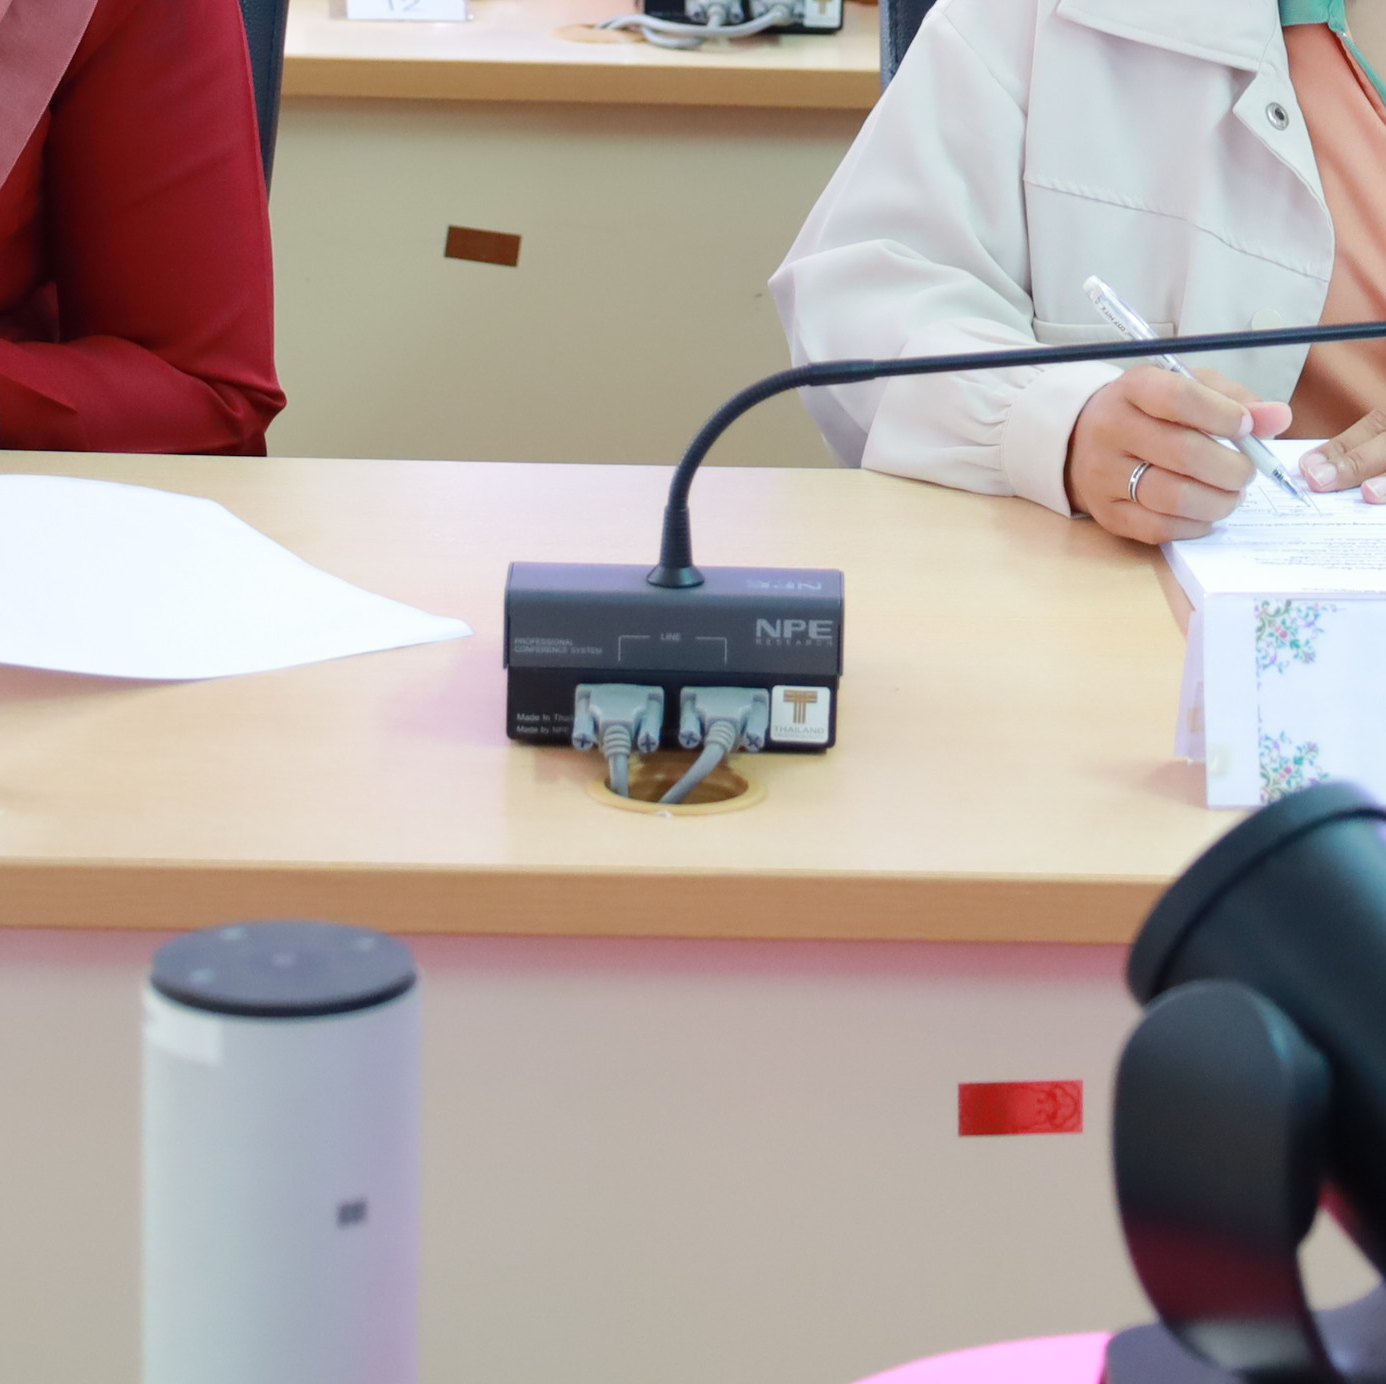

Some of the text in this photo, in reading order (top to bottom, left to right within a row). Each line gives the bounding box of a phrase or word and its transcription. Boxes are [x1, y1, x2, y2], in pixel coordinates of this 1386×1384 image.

[756, 618, 833, 639] NPE
[660, 632, 682, 641] LINE
[514, 637, 574, 646] PROFESSIONAL
[756, 639, 833, 647] RESEARCH
[570, 647, 603, 655] SYSTEM
[517, 713, 540, 721] Made
[774, 725, 825, 735] THAILAND
